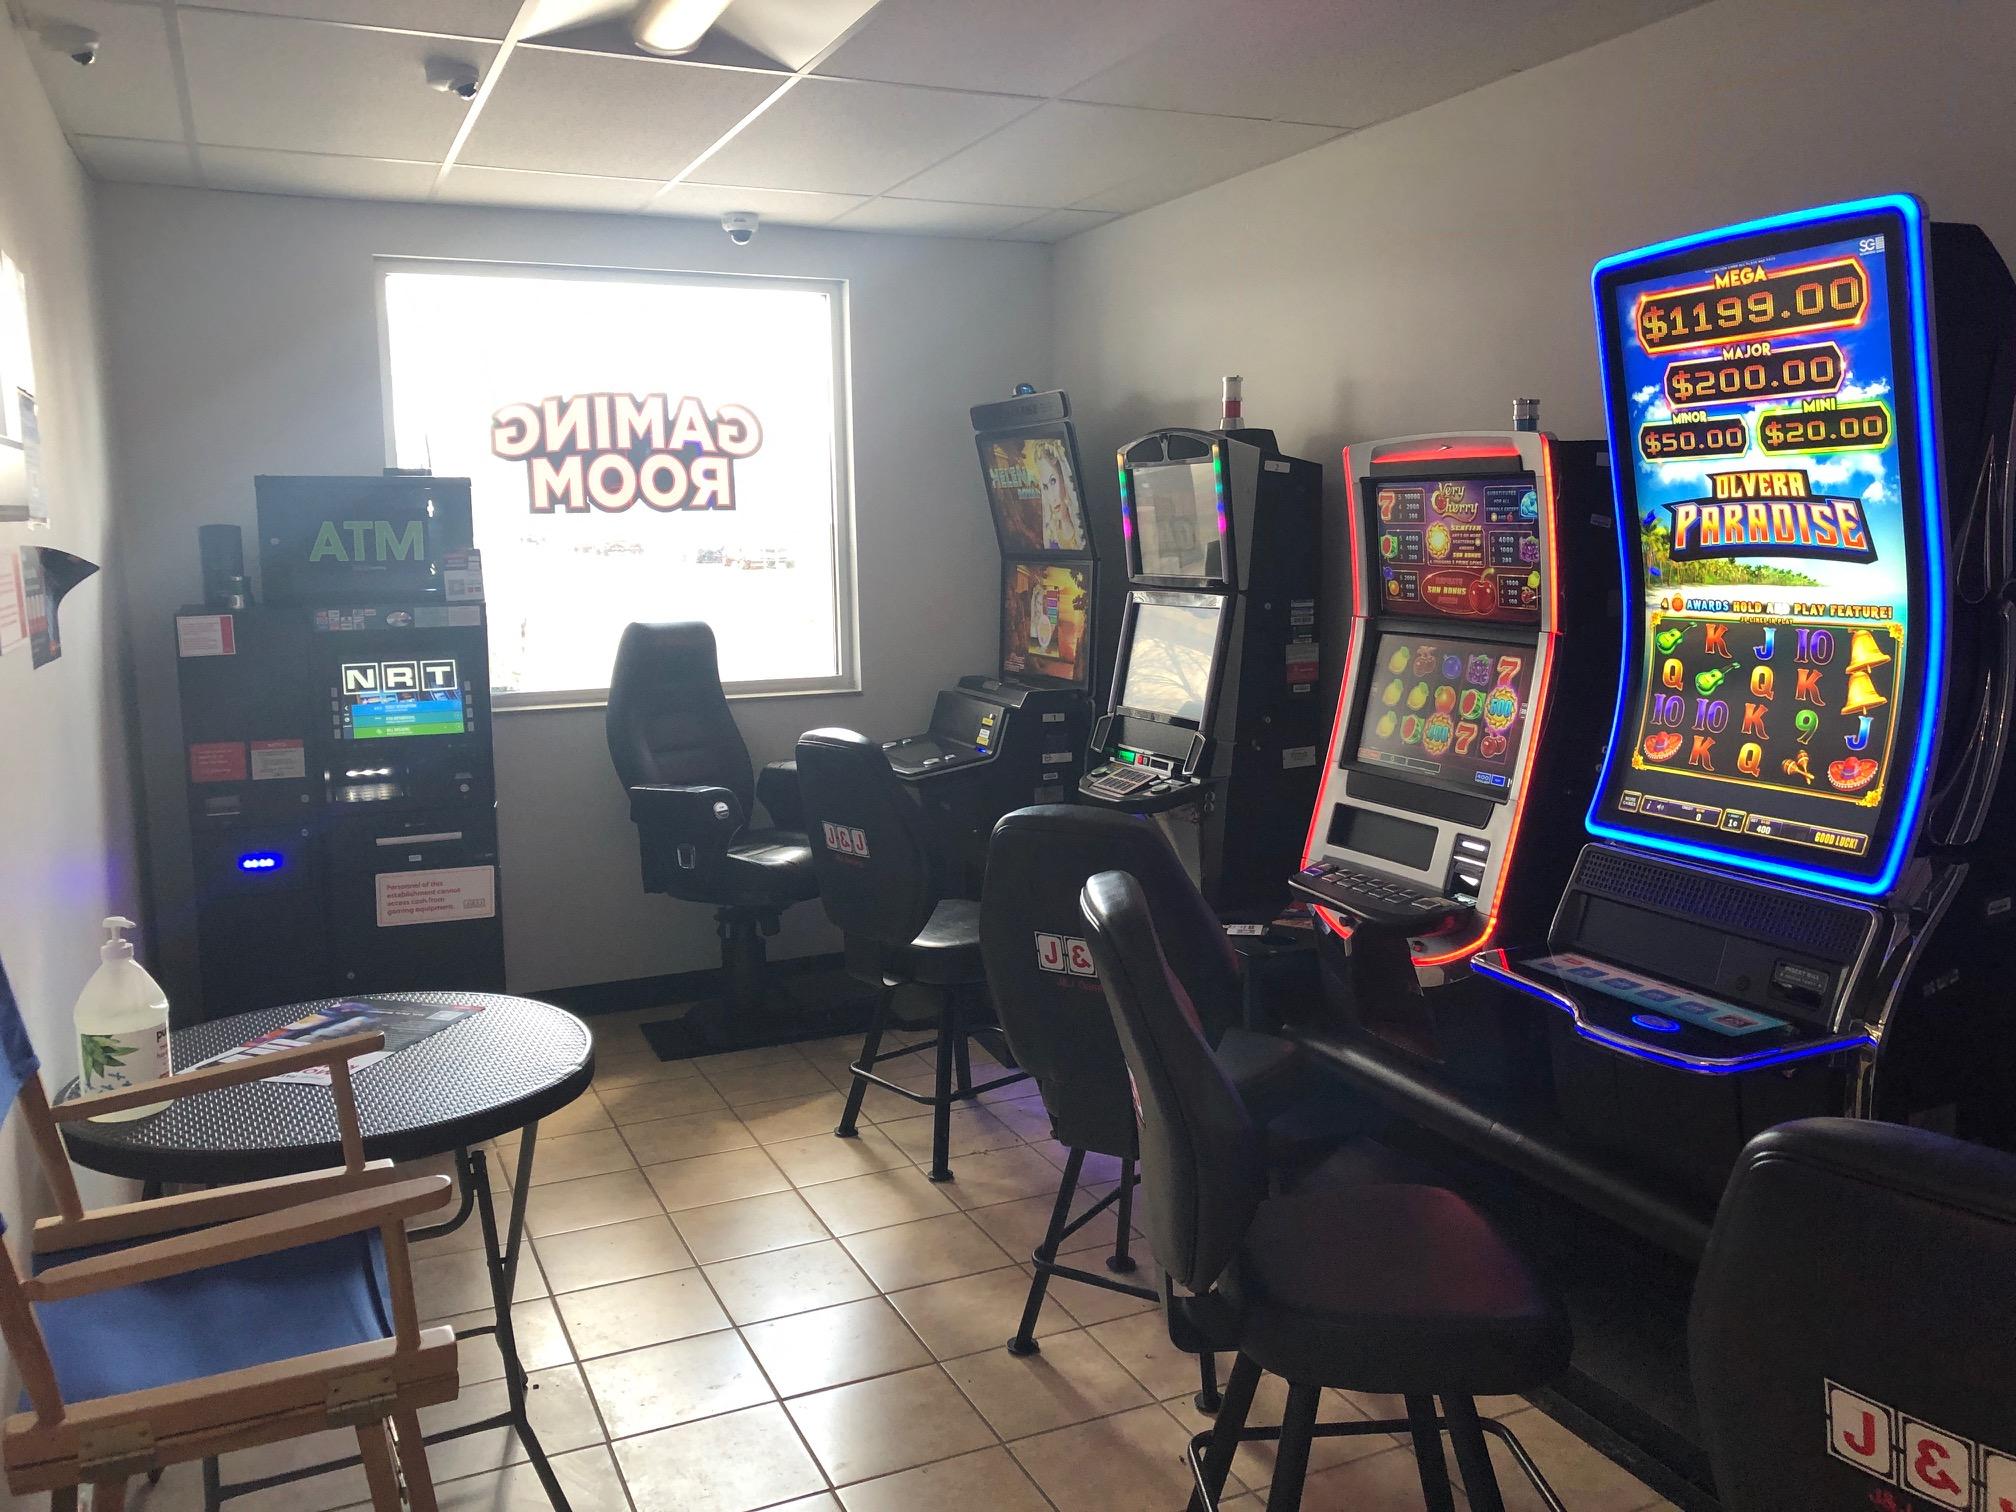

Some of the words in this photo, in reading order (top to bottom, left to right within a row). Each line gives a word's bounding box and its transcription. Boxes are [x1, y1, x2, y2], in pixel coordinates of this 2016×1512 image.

[1859, 238, 1875, 252] SG
[1714, 266, 1768, 289] MEGA
[1642, 276, 1859, 342] $1199.00
[1722, 341, 1772, 361] MAJOR
[1671, 355, 1835, 400] $200.00
[1672, 410, 1707, 425] MINOR
[1802, 397, 1837, 413] MINI
[1645, 427, 1743, 456] $50.00
[1764, 415, 1883, 447] $20.00
[1715, 472, 1806, 500] OLVERA
[1431, 490, 1478, 521] Cherry
[1673, 500, 1866, 551] PARADISE
[310, 521, 424, 562] ATM
[1660, 598, 1669, 610] 4
[1686, 599, 1729, 612] AWARDS
[1733, 601, 1762, 613] HOLD
[1793, 603, 1825, 617] PLAY
[1829, 604, 1893, 620] FEATURE!
[1704, 623, 1732, 658] K
[1753, 627, 1777, 661] J
[1795, 629, 1835, 666] 10
[344, 665, 453, 691] NRT
[1662, 658, 1684, 691] Q
[1750, 666, 1775, 701] Q
[1795, 668, 1826, 707] K
[1650, 693, 1685, 728] 10
[1692, 698, 1729, 734] 10
[1741, 703, 1770, 740] K
[1795, 709, 1819, 745] 9
[1844, 716, 1874, 750] J
[1689, 735, 1715, 772] K
[1737, 742, 1762, 778] Q
[1814, 832, 1834, 845] GOOD
[386, 881, 420, 891] Personnel
[430, 880, 443, 888] this
[387, 889, 435, 899] establishment
[437, 887, 461, 895] cannot
[387, 907, 414, 916] gaming
[1843, 1411, 2016, 1512] J&
